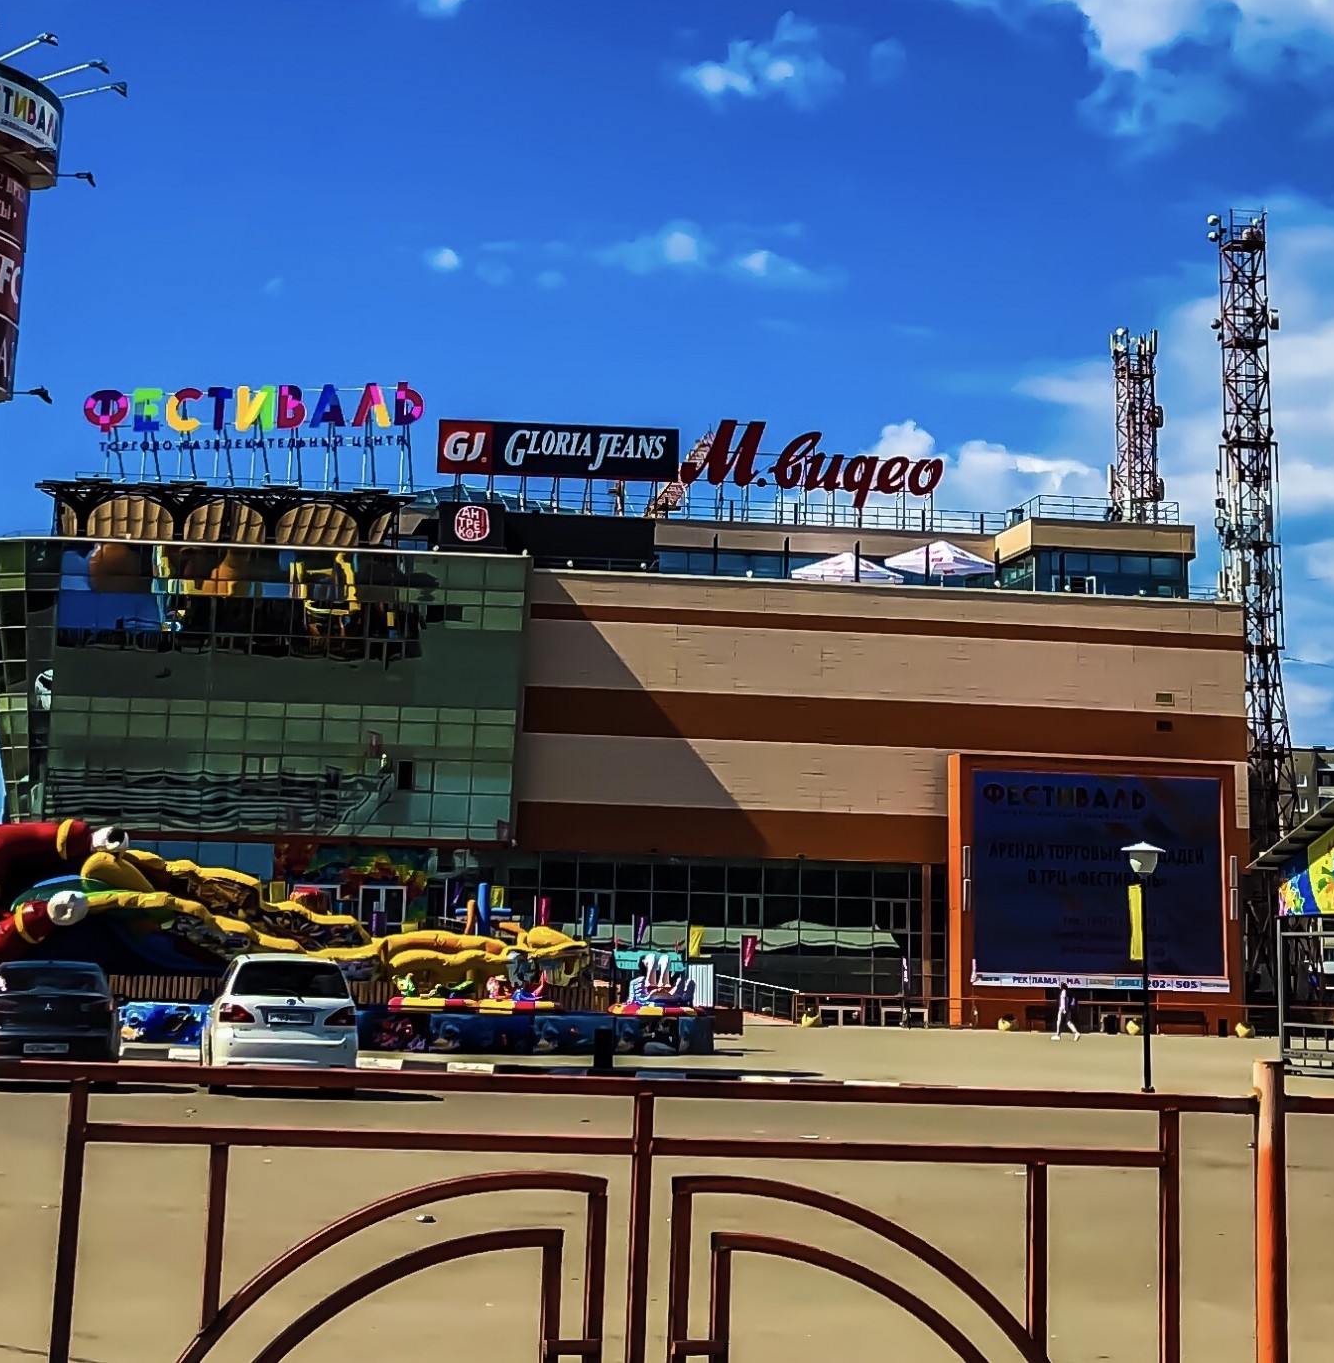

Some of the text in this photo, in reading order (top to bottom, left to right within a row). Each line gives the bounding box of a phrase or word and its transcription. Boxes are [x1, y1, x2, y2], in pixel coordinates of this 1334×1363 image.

[83, 381, 425, 432] ФЕСТИВАЛЬ
[504, 429, 667, 472] GLORIA JEANS
[681, 418, 945, 510] М.видео
[983, 783, 1146, 811] ФЕСТИВАЛЬ
[989, 842, 1043, 862] АРЕНДА
[1040, 870, 1066, 886] ТРЦ
